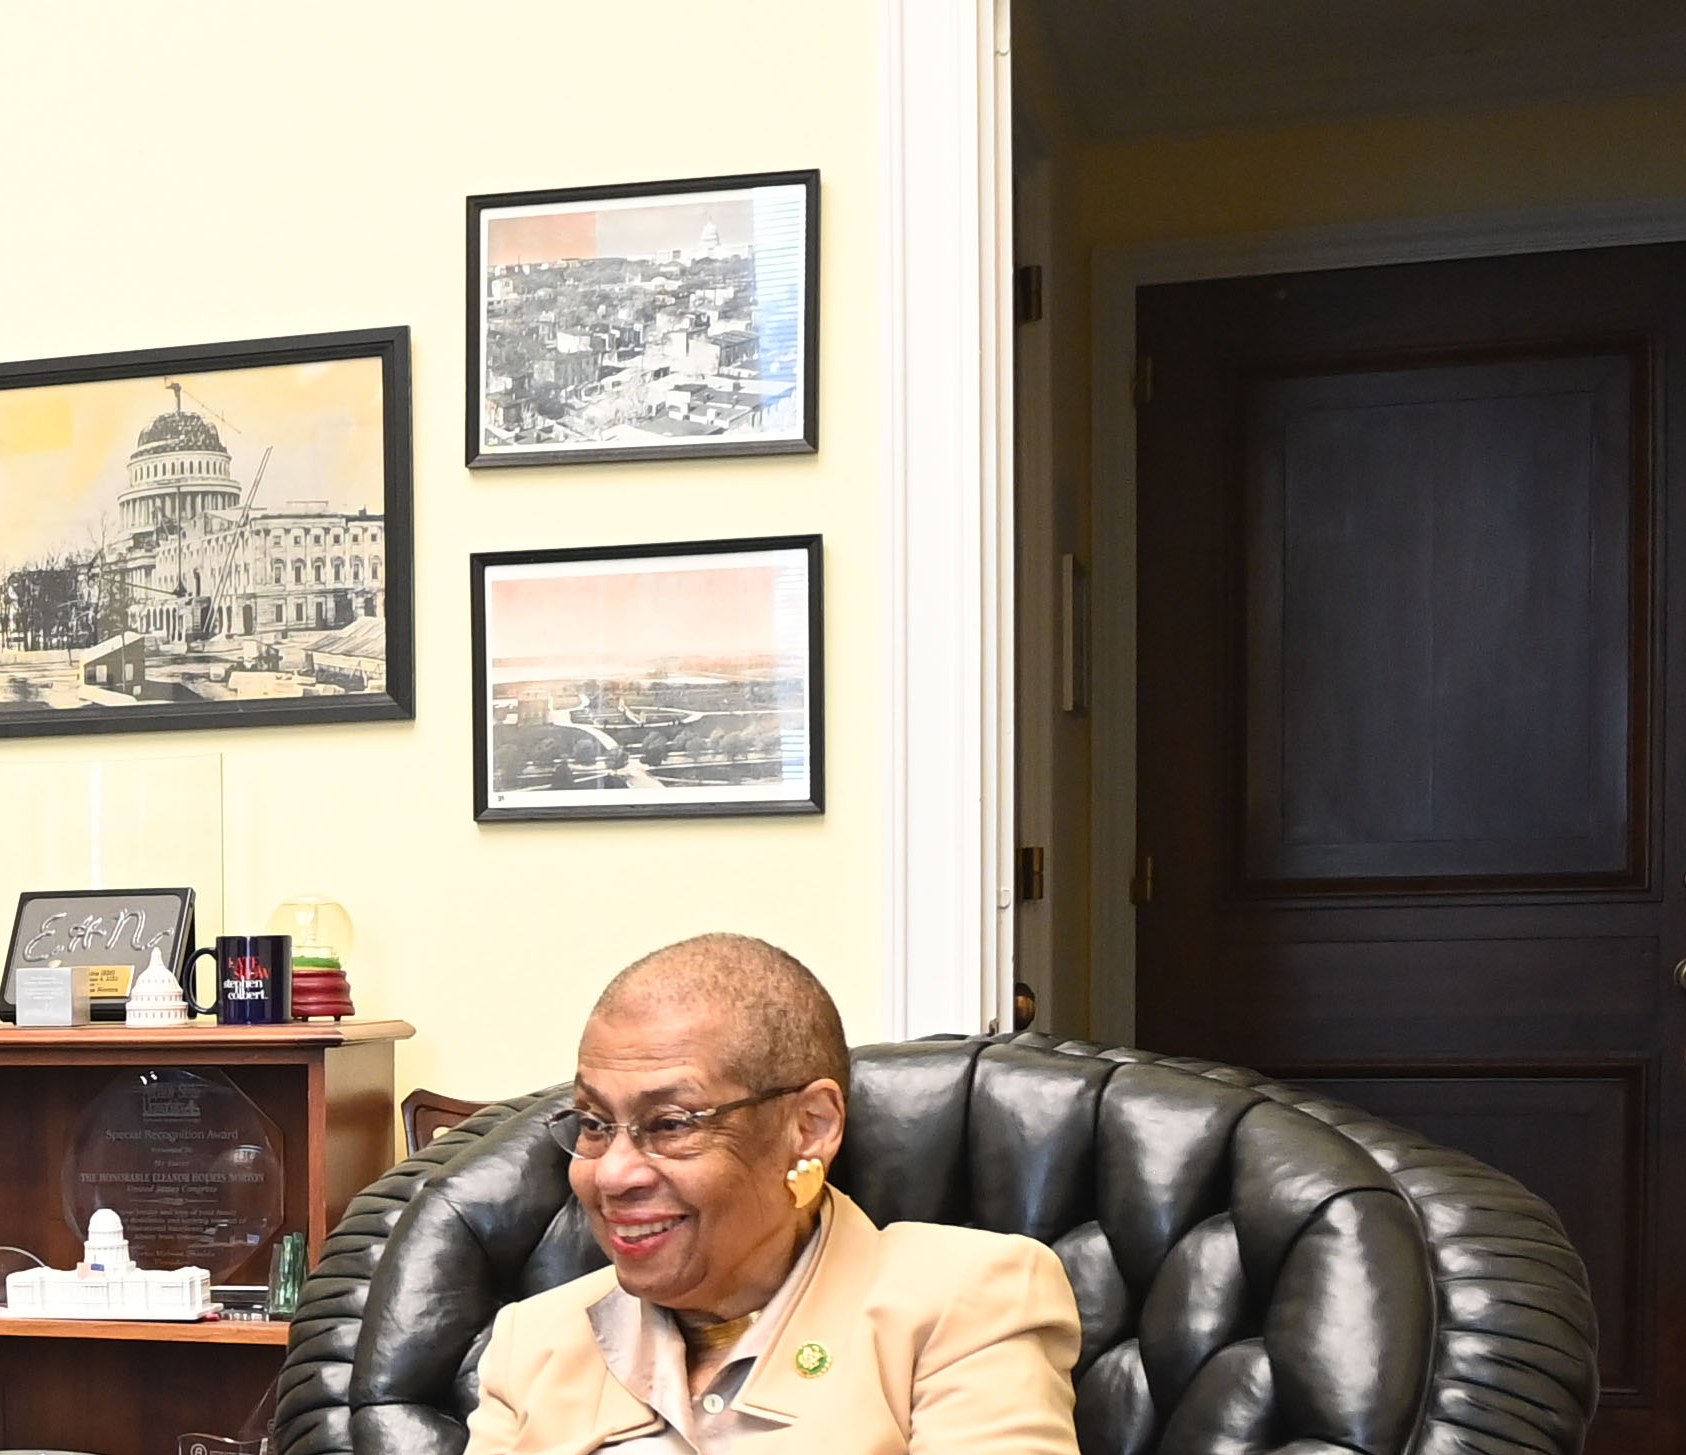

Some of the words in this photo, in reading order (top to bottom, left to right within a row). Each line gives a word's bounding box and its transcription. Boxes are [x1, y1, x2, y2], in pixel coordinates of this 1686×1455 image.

[223, 977, 263, 991] stephen
[227, 989, 265, 1000] colbert
[106, 1129, 141, 1142] Special
[145, 1129, 204, 1143] Recognition
[207, 1129, 239, 1140] Award
[81, 1172, 97, 1183] THE
[99, 1173, 151, 1183] HONORABLE
[152, 1173, 190, 1183] ELEANOR
[192, 1173, 227, 1184] HOLMES
[229, 1173, 265, 1183] NORTON
